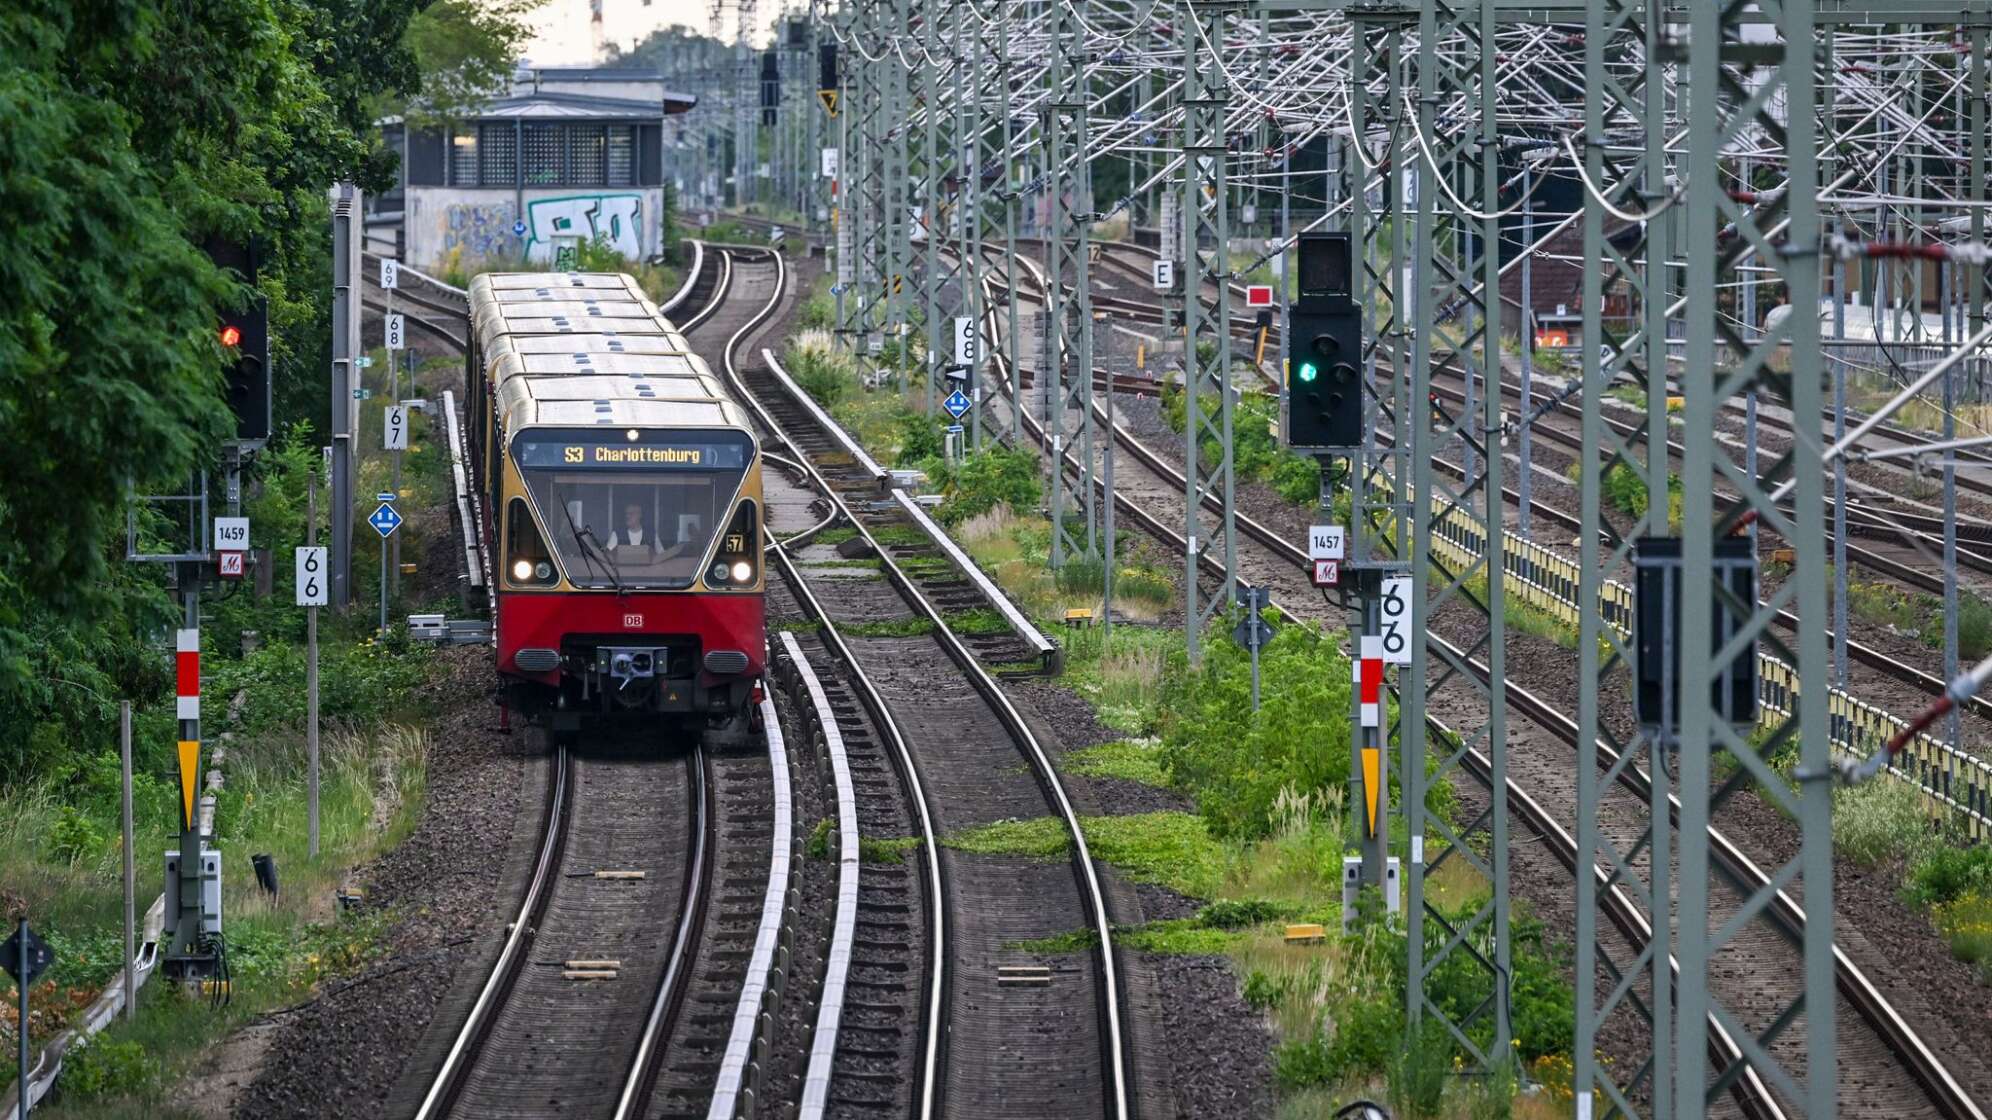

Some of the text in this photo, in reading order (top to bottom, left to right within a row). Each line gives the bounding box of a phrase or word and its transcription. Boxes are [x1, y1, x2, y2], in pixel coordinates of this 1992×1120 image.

[1158, 264, 1169, 284] E
[391, 317, 399, 330] 6
[963, 320, 974, 338] 6
[391, 332, 399, 345] 8
[964, 341, 974, 359] 8
[391, 410, 401, 425] 6
[392, 428, 400, 443] 7
[564, 446, 700, 464] S3 Charlottenburg
[219, 527, 245, 541] 1459
[727, 536, 741, 551] 57
[1313, 536, 1339, 549] 1457
[305, 551, 318, 573] 6
[305, 576, 319, 598] 6
[1383, 584, 1405, 617] 6
[625, 614, 642, 627] DB
[1383, 620, 1405, 653] 6
